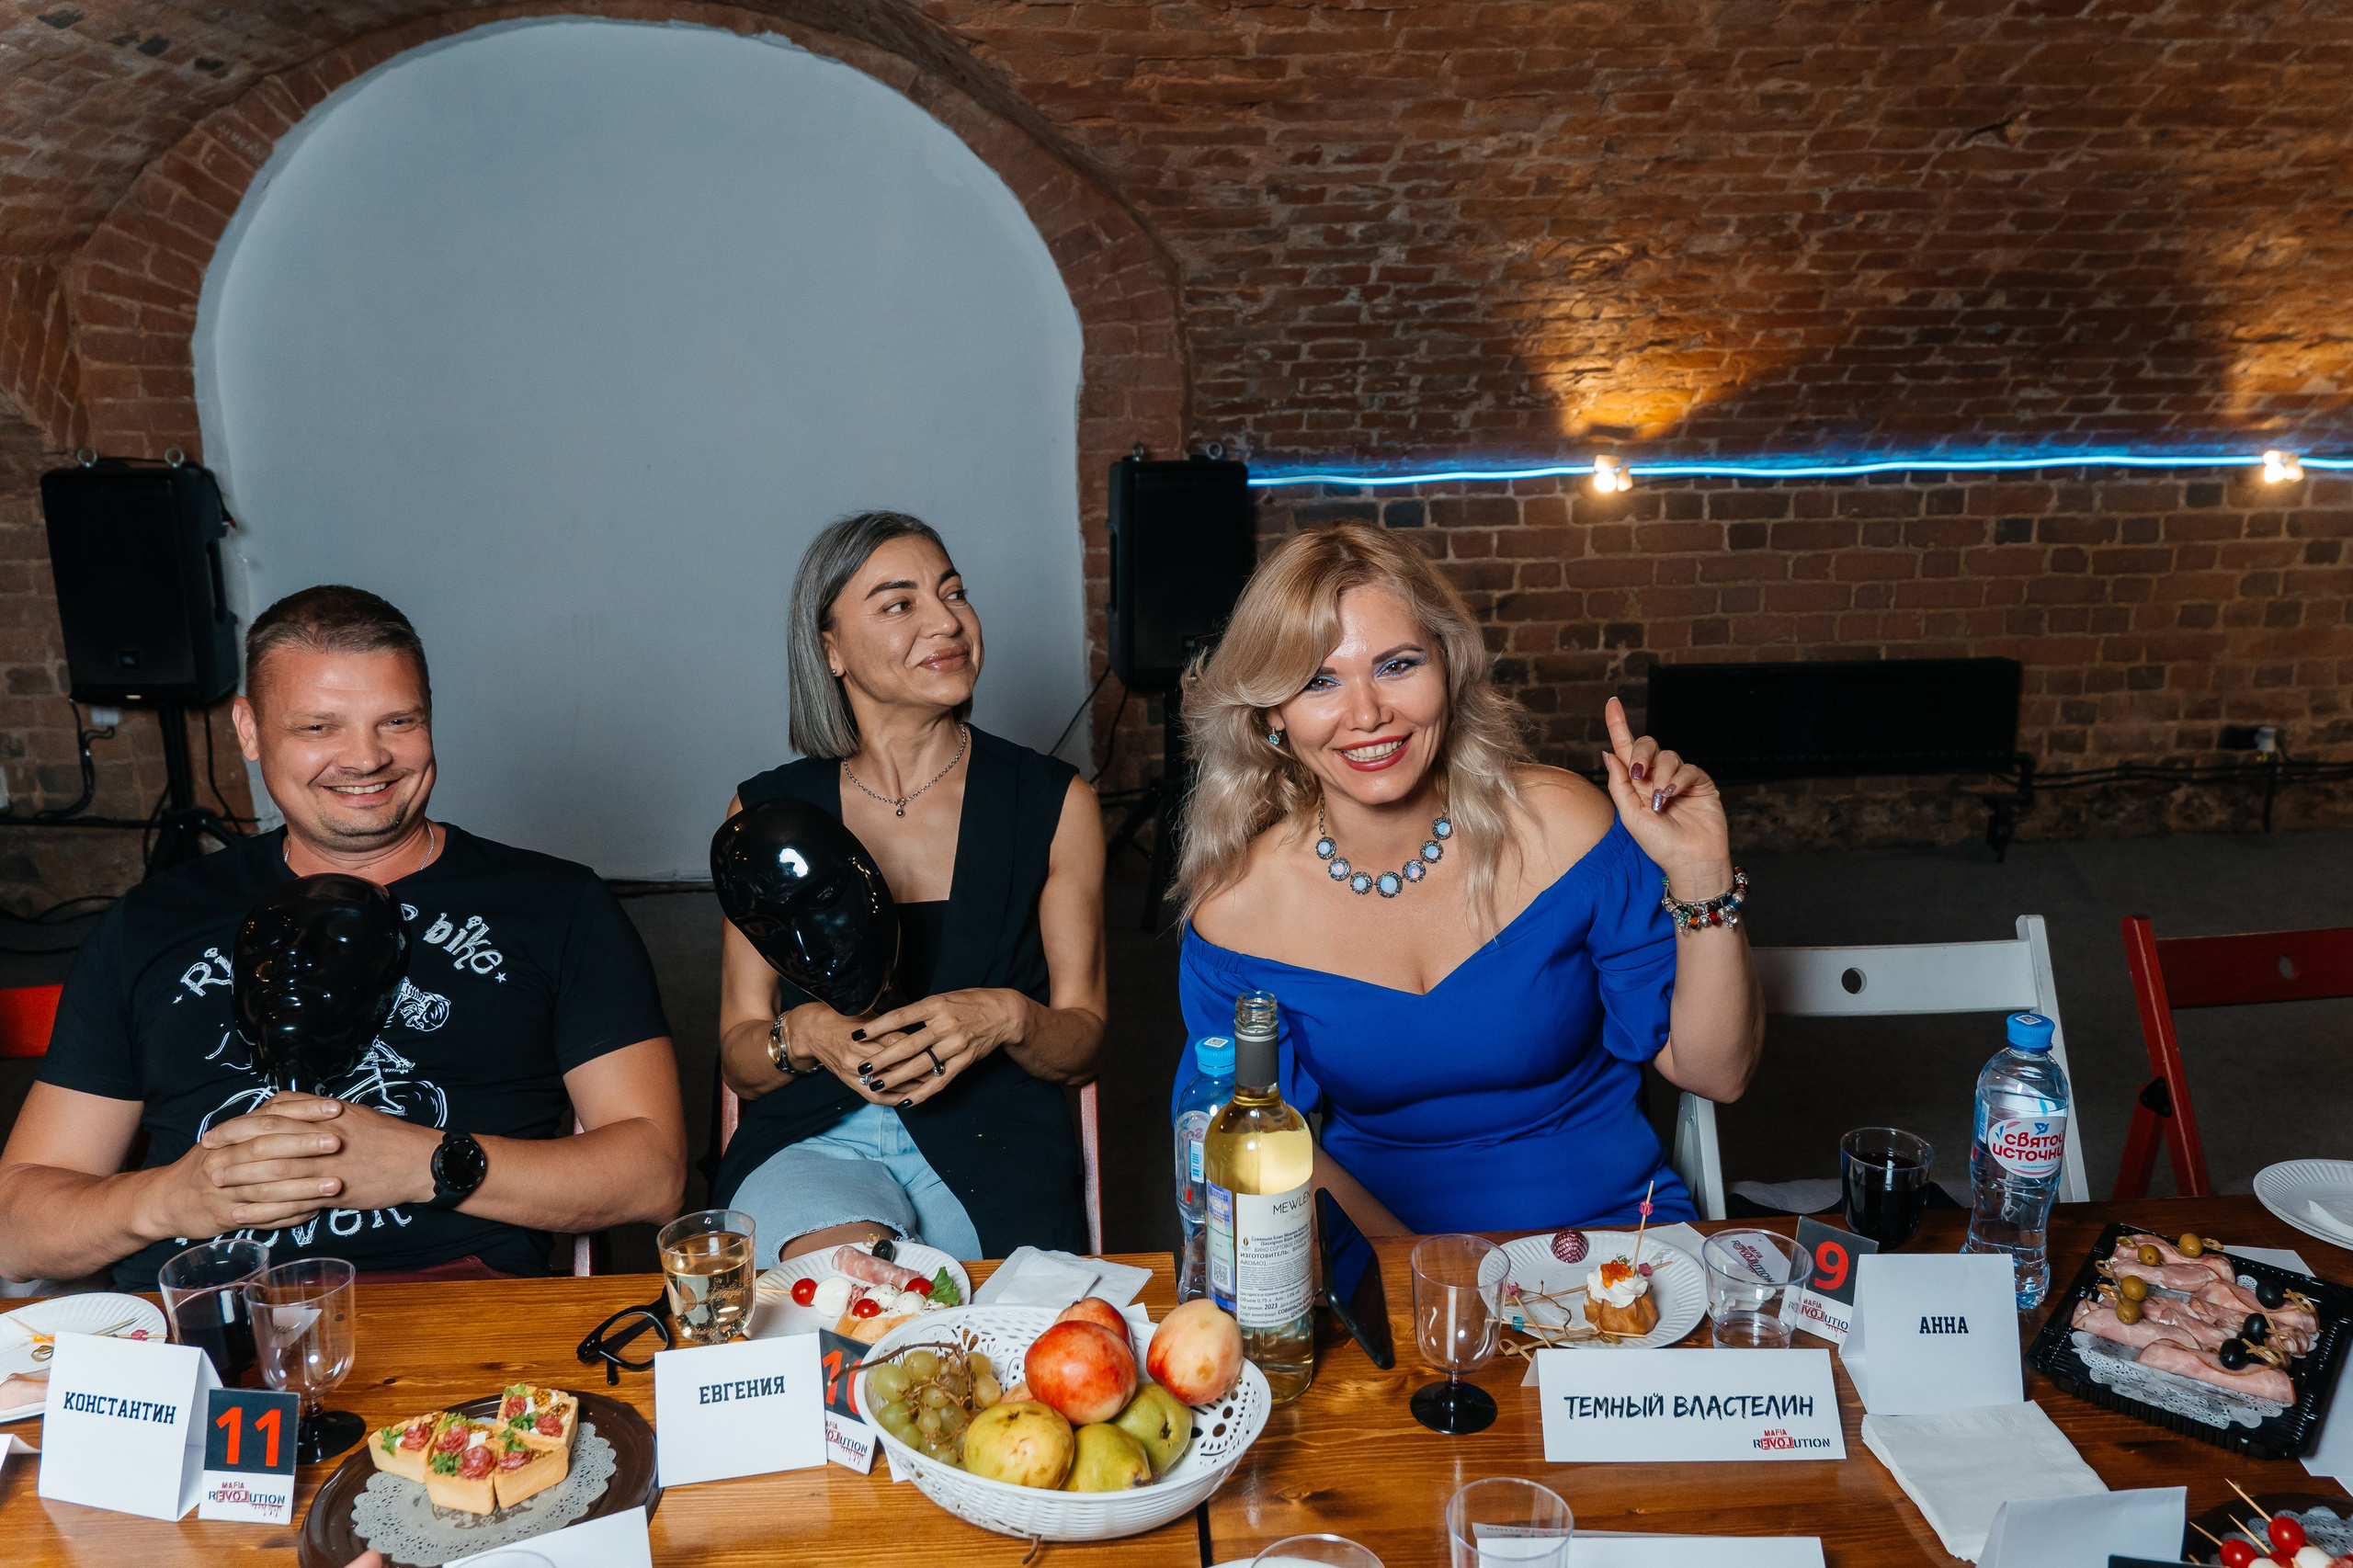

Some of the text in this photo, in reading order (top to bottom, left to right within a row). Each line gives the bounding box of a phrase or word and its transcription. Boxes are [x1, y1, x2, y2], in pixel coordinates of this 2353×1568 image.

[423, 913, 504, 974] bike
[180, 948, 233, 996] Ri
[1814, 1241, 1848, 1290] 9
[1789, 1301, 1848, 1330] REVOLUTIO
[1919, 1316, 1970, 1334] АННА
[699, 1375, 785, 1404] ЕВГЕНИЯ
[63, 1391, 177, 1425] КОНСТАНТИН
[1563, 1392, 1814, 1421] ТЕМНЫЙ ВЛАСТЕЛИН
[216, 1406, 281, 1467] 11
[825, 1420, 838, 1430] AFIA
[1764, 1428, 1788, 1437] MAFIA
